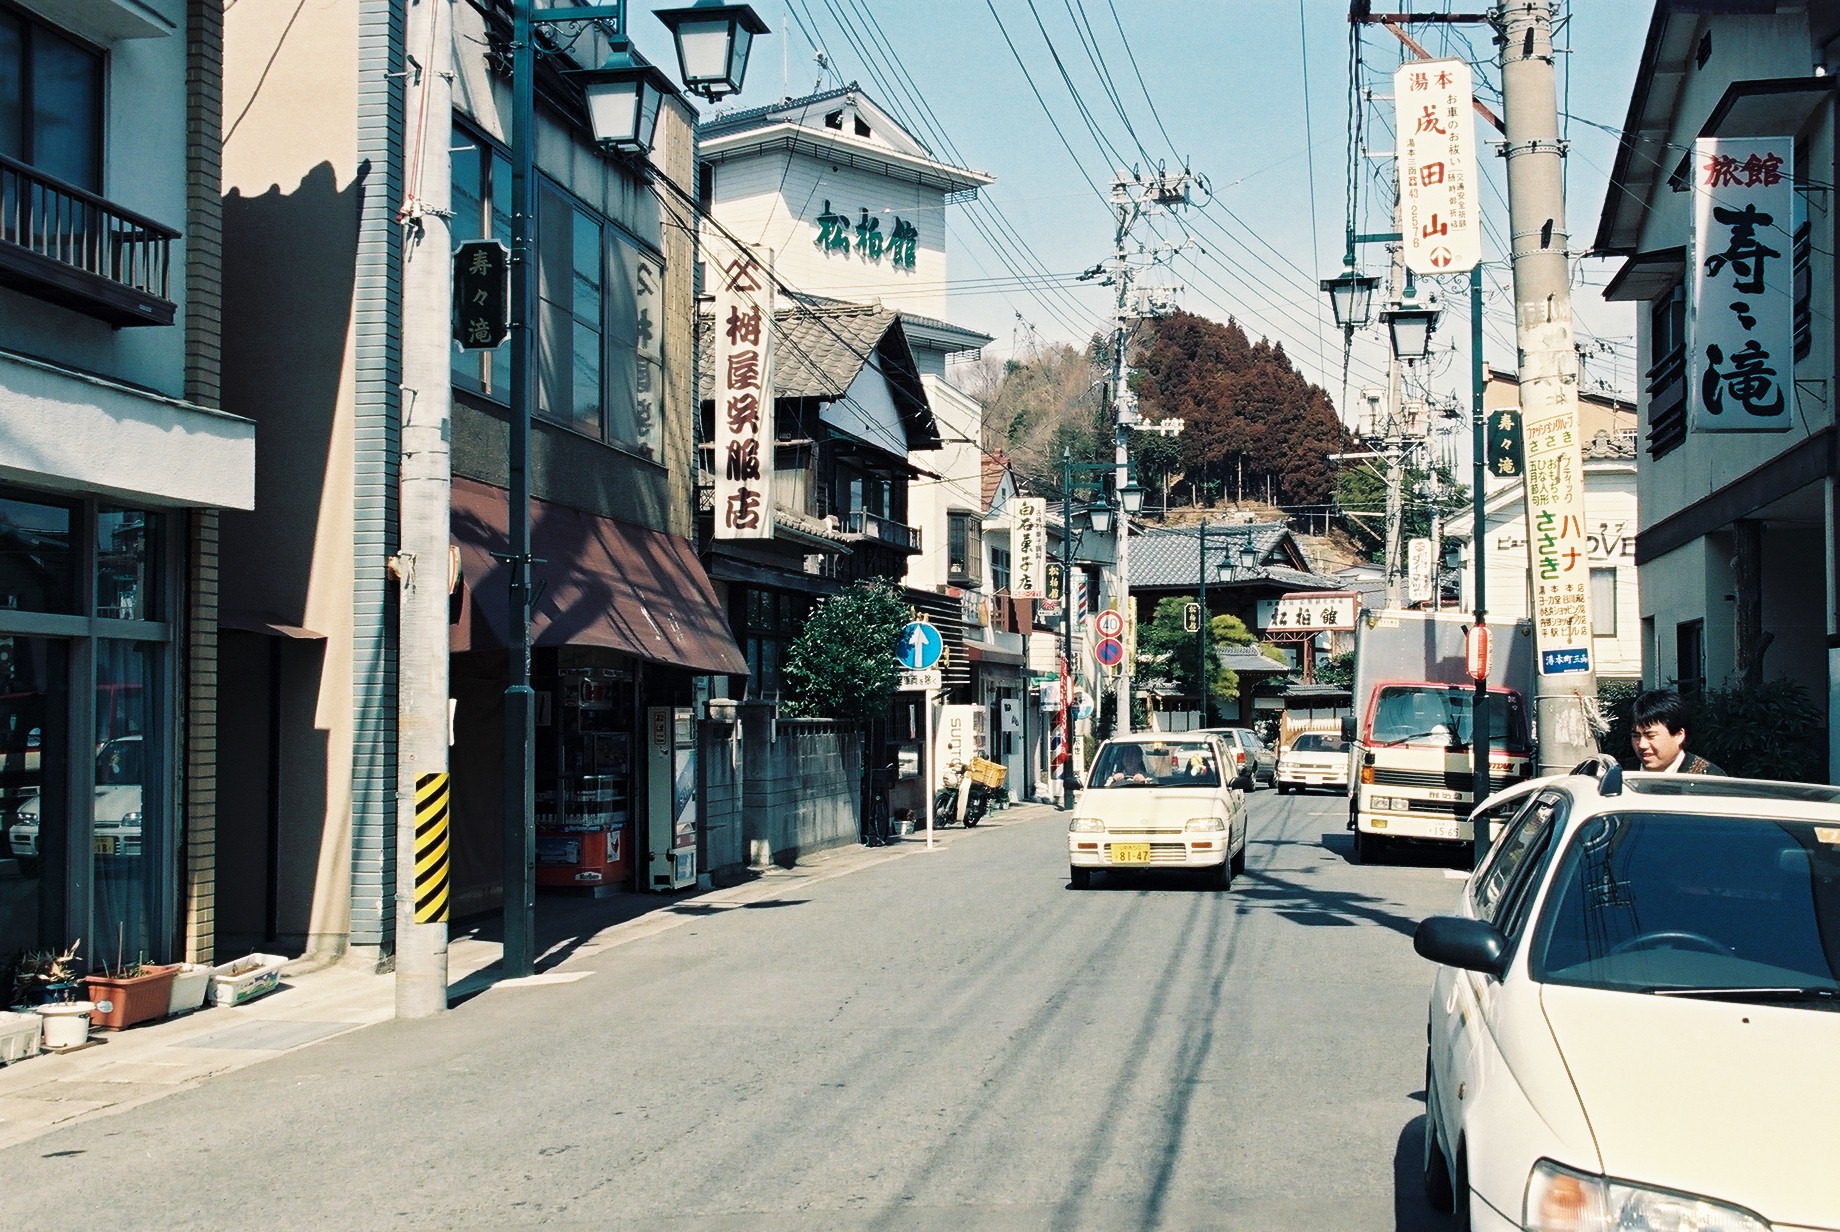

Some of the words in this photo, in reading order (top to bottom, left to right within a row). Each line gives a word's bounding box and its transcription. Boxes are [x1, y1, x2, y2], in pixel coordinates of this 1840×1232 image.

[1409, 70, 1453, 92] 湯本
[1447, 94, 1461, 166] お車のお祓い
[1414, 104, 1448, 240] 成田山
[1703, 152, 1784, 188] 旅館
[813, 199, 918, 269] 松柏館
[468, 249, 493, 343] 寿々滝
[1498, 413, 1515, 474] 寿々滝
[1529, 430, 1572, 453] ささき
[1537, 459, 1549, 506] ひな人形
[1535, 509, 1560, 581] ささき
[1560, 515, 1582, 572] ハナ
[1102, 618, 1118, 630] 40
[1271, 605, 1338, 627] 松柏館
[1119, 851, 1149, 861] 81-47
